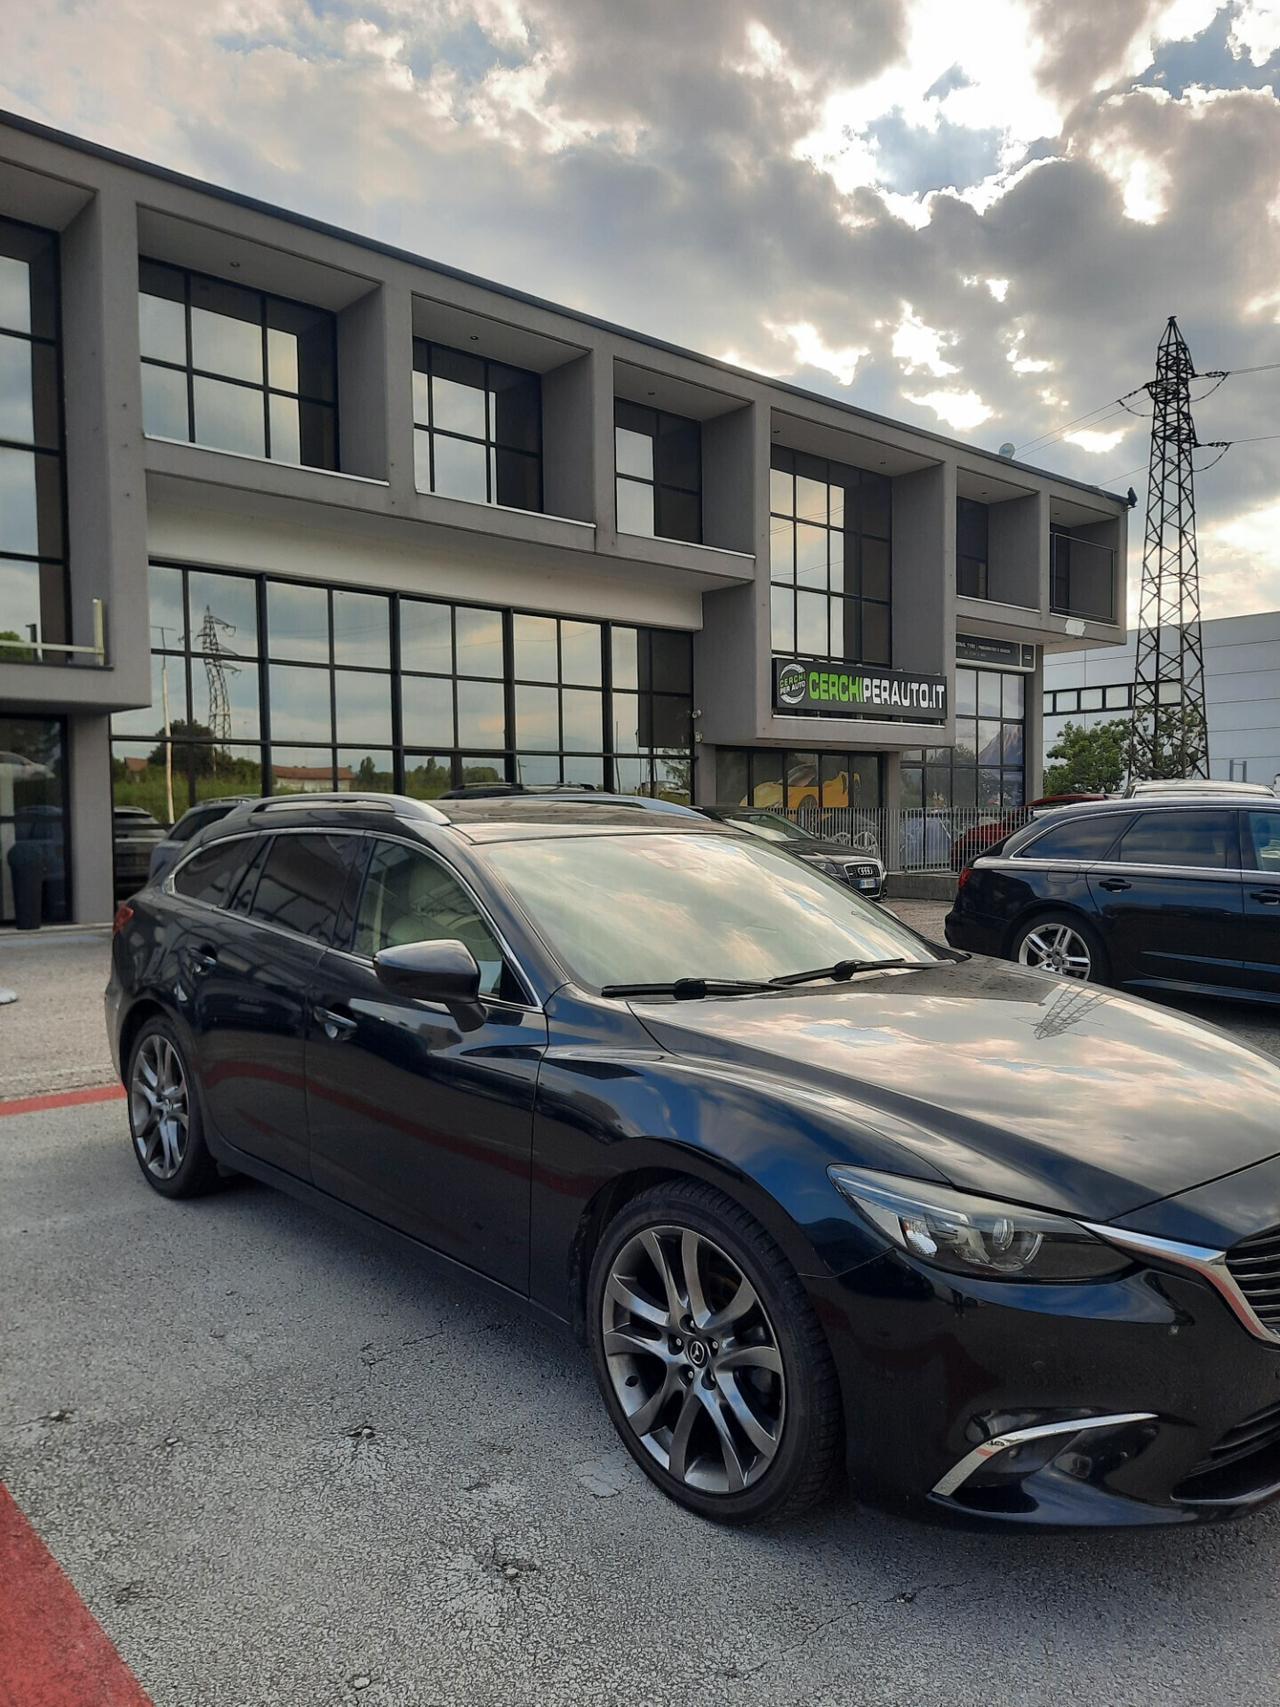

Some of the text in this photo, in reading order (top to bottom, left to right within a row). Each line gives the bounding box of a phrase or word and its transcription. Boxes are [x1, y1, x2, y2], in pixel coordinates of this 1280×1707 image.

[780, 672, 807, 688] CERCHI
[791, 680, 806, 691] AUTO
[809, 671, 945, 709] CERCHIPERAUTO.IT
